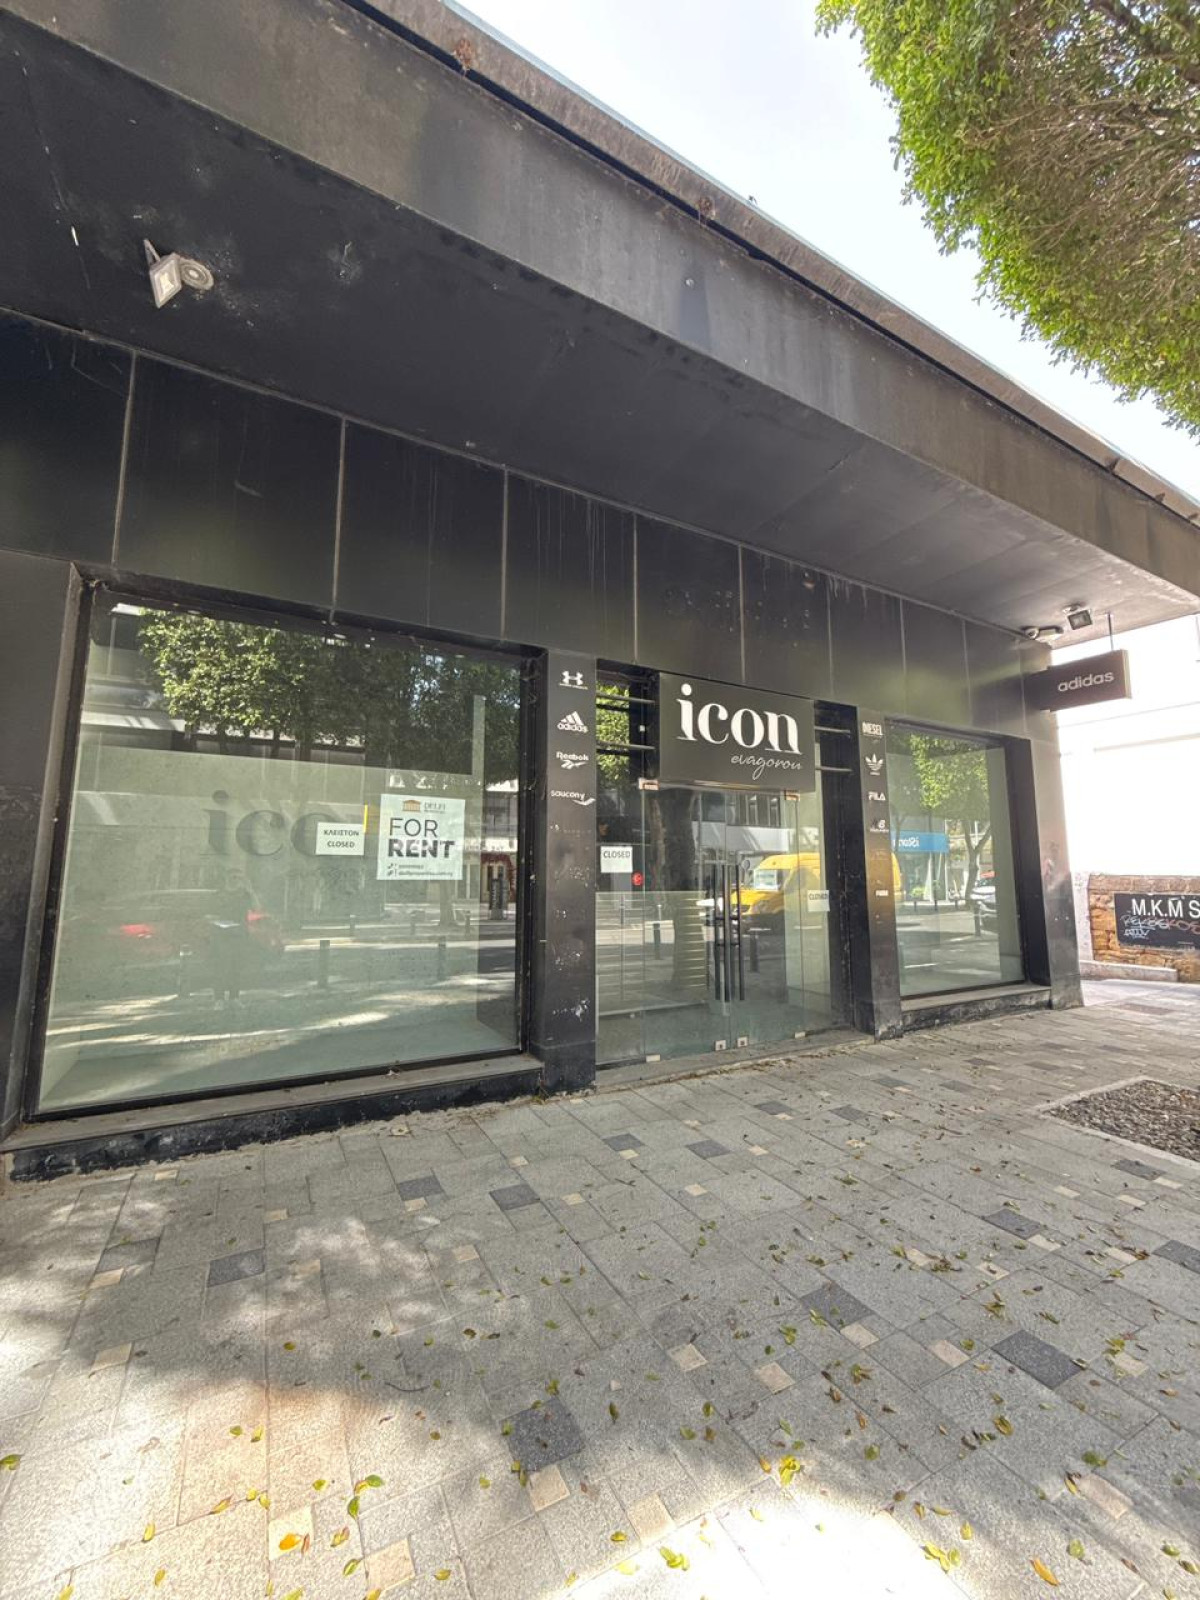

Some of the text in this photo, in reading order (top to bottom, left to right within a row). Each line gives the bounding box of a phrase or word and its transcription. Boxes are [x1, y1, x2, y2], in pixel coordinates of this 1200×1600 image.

[1058, 672, 1115, 692] adidas
[676, 683, 802, 755] icon
[557, 722, 588, 733] adidas
[556, 751, 589, 761] Reebok
[551, 789, 585, 799] saucony
[868, 792, 886, 801] FILA
[390, 817, 438, 838] FOR
[327, 840, 356, 849] CLOSED
[388, 838, 455, 859] RENT
[603, 850, 631, 859] CLOSED
[1131, 899, 1184, 918] M.K.M
